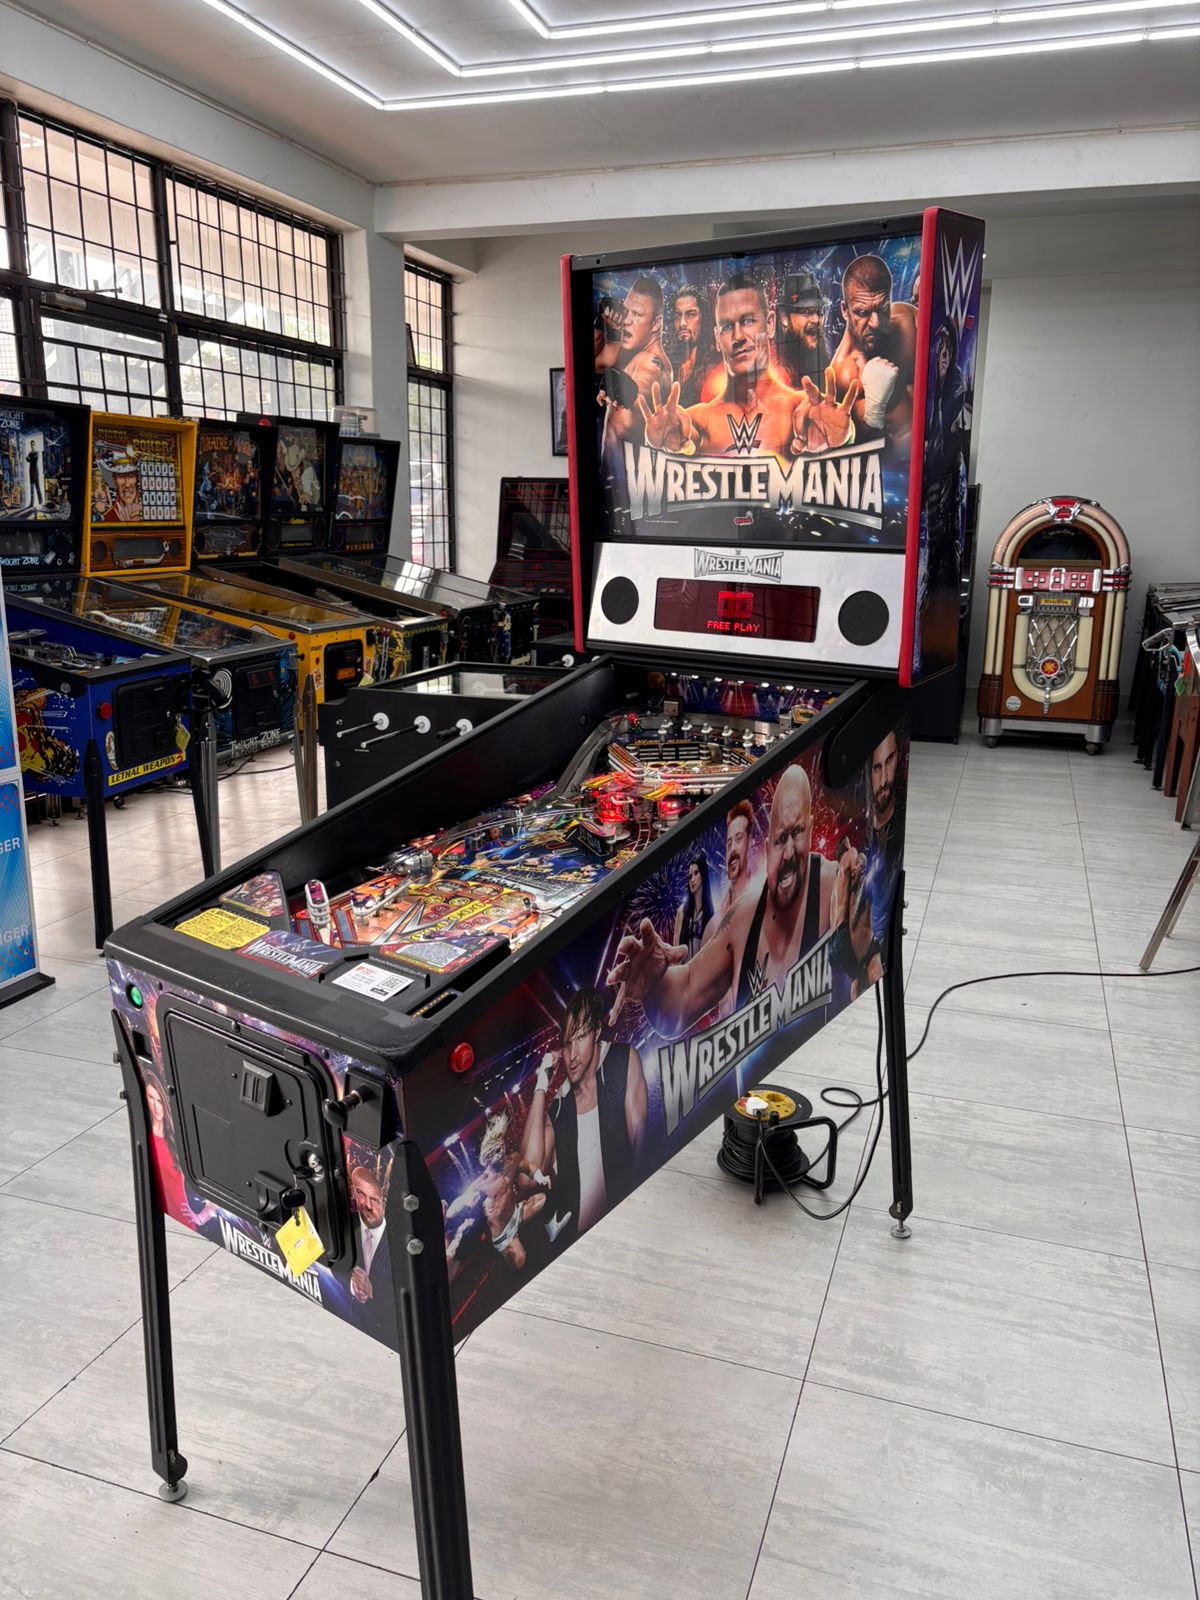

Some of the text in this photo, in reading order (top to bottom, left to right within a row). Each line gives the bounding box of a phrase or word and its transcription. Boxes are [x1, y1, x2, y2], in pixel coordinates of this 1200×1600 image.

[21, 556, 39, 565] ZONE
[707, 620, 760, 633] FREE PLAY
[260, 728, 281, 742] ZONE
[111, 768, 142, 783] LETHAL
[143, 755, 177, 772] WEAPON
